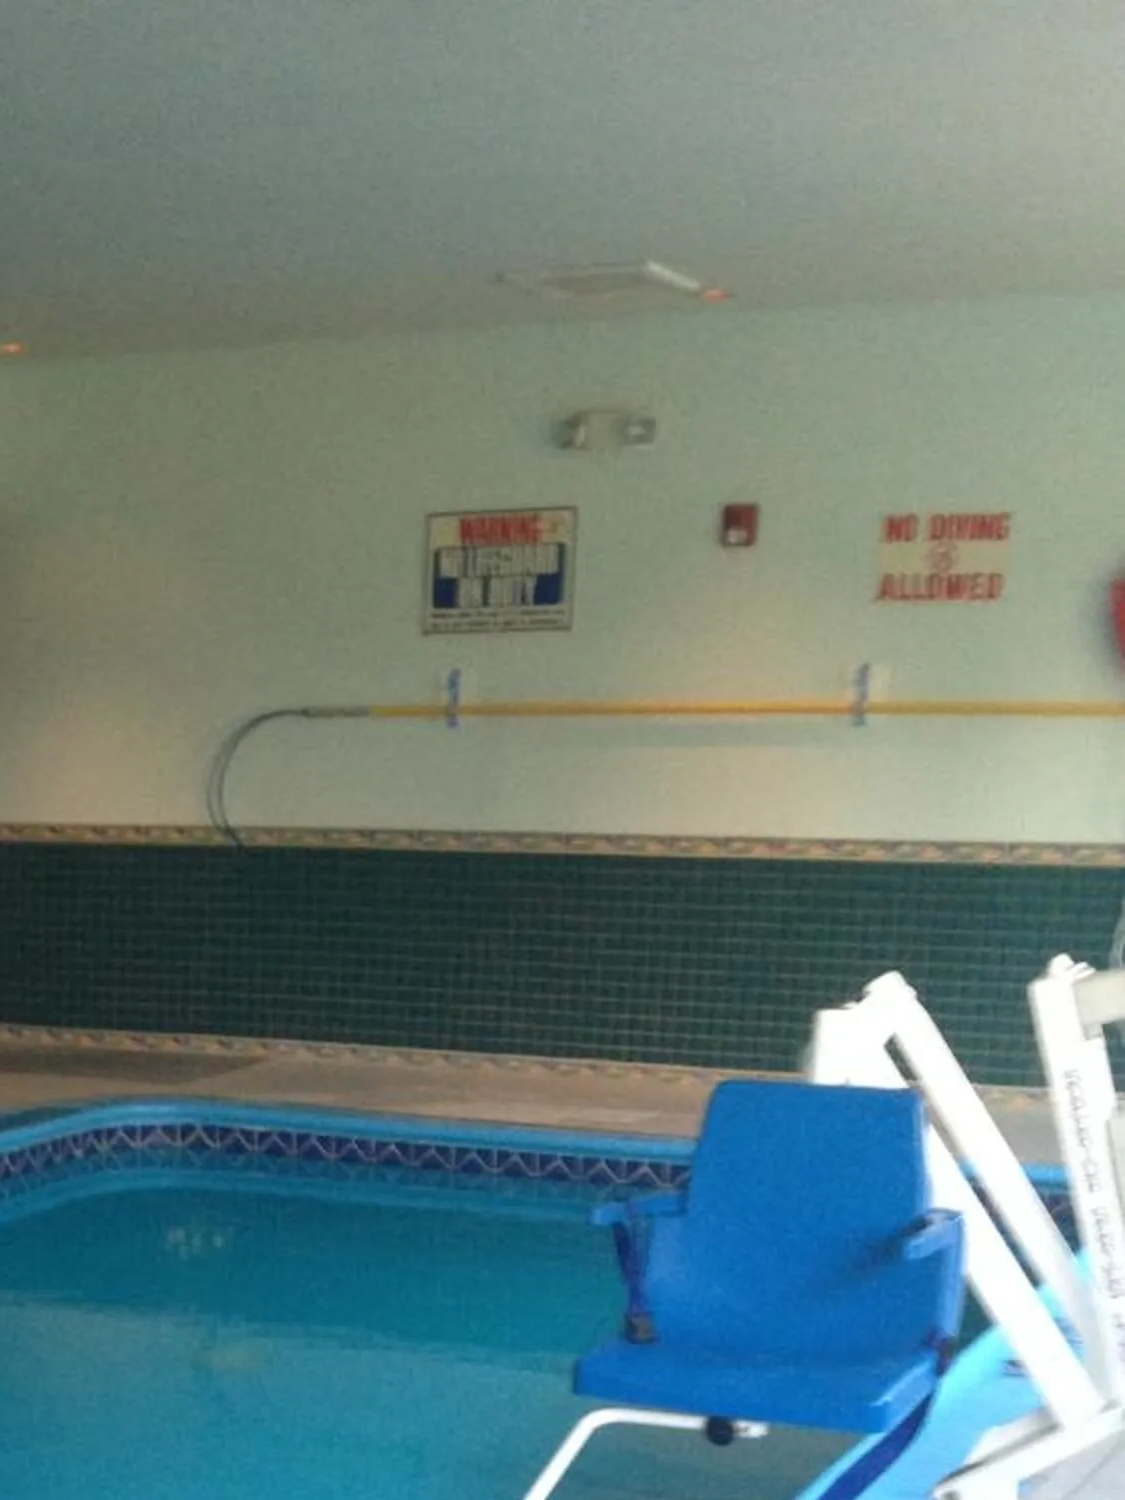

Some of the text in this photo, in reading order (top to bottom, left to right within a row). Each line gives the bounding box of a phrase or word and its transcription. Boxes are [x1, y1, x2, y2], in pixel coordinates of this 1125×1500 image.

[883, 512, 1011, 543] NO DIVING
[876, 573, 1004, 600] ALLOWED
